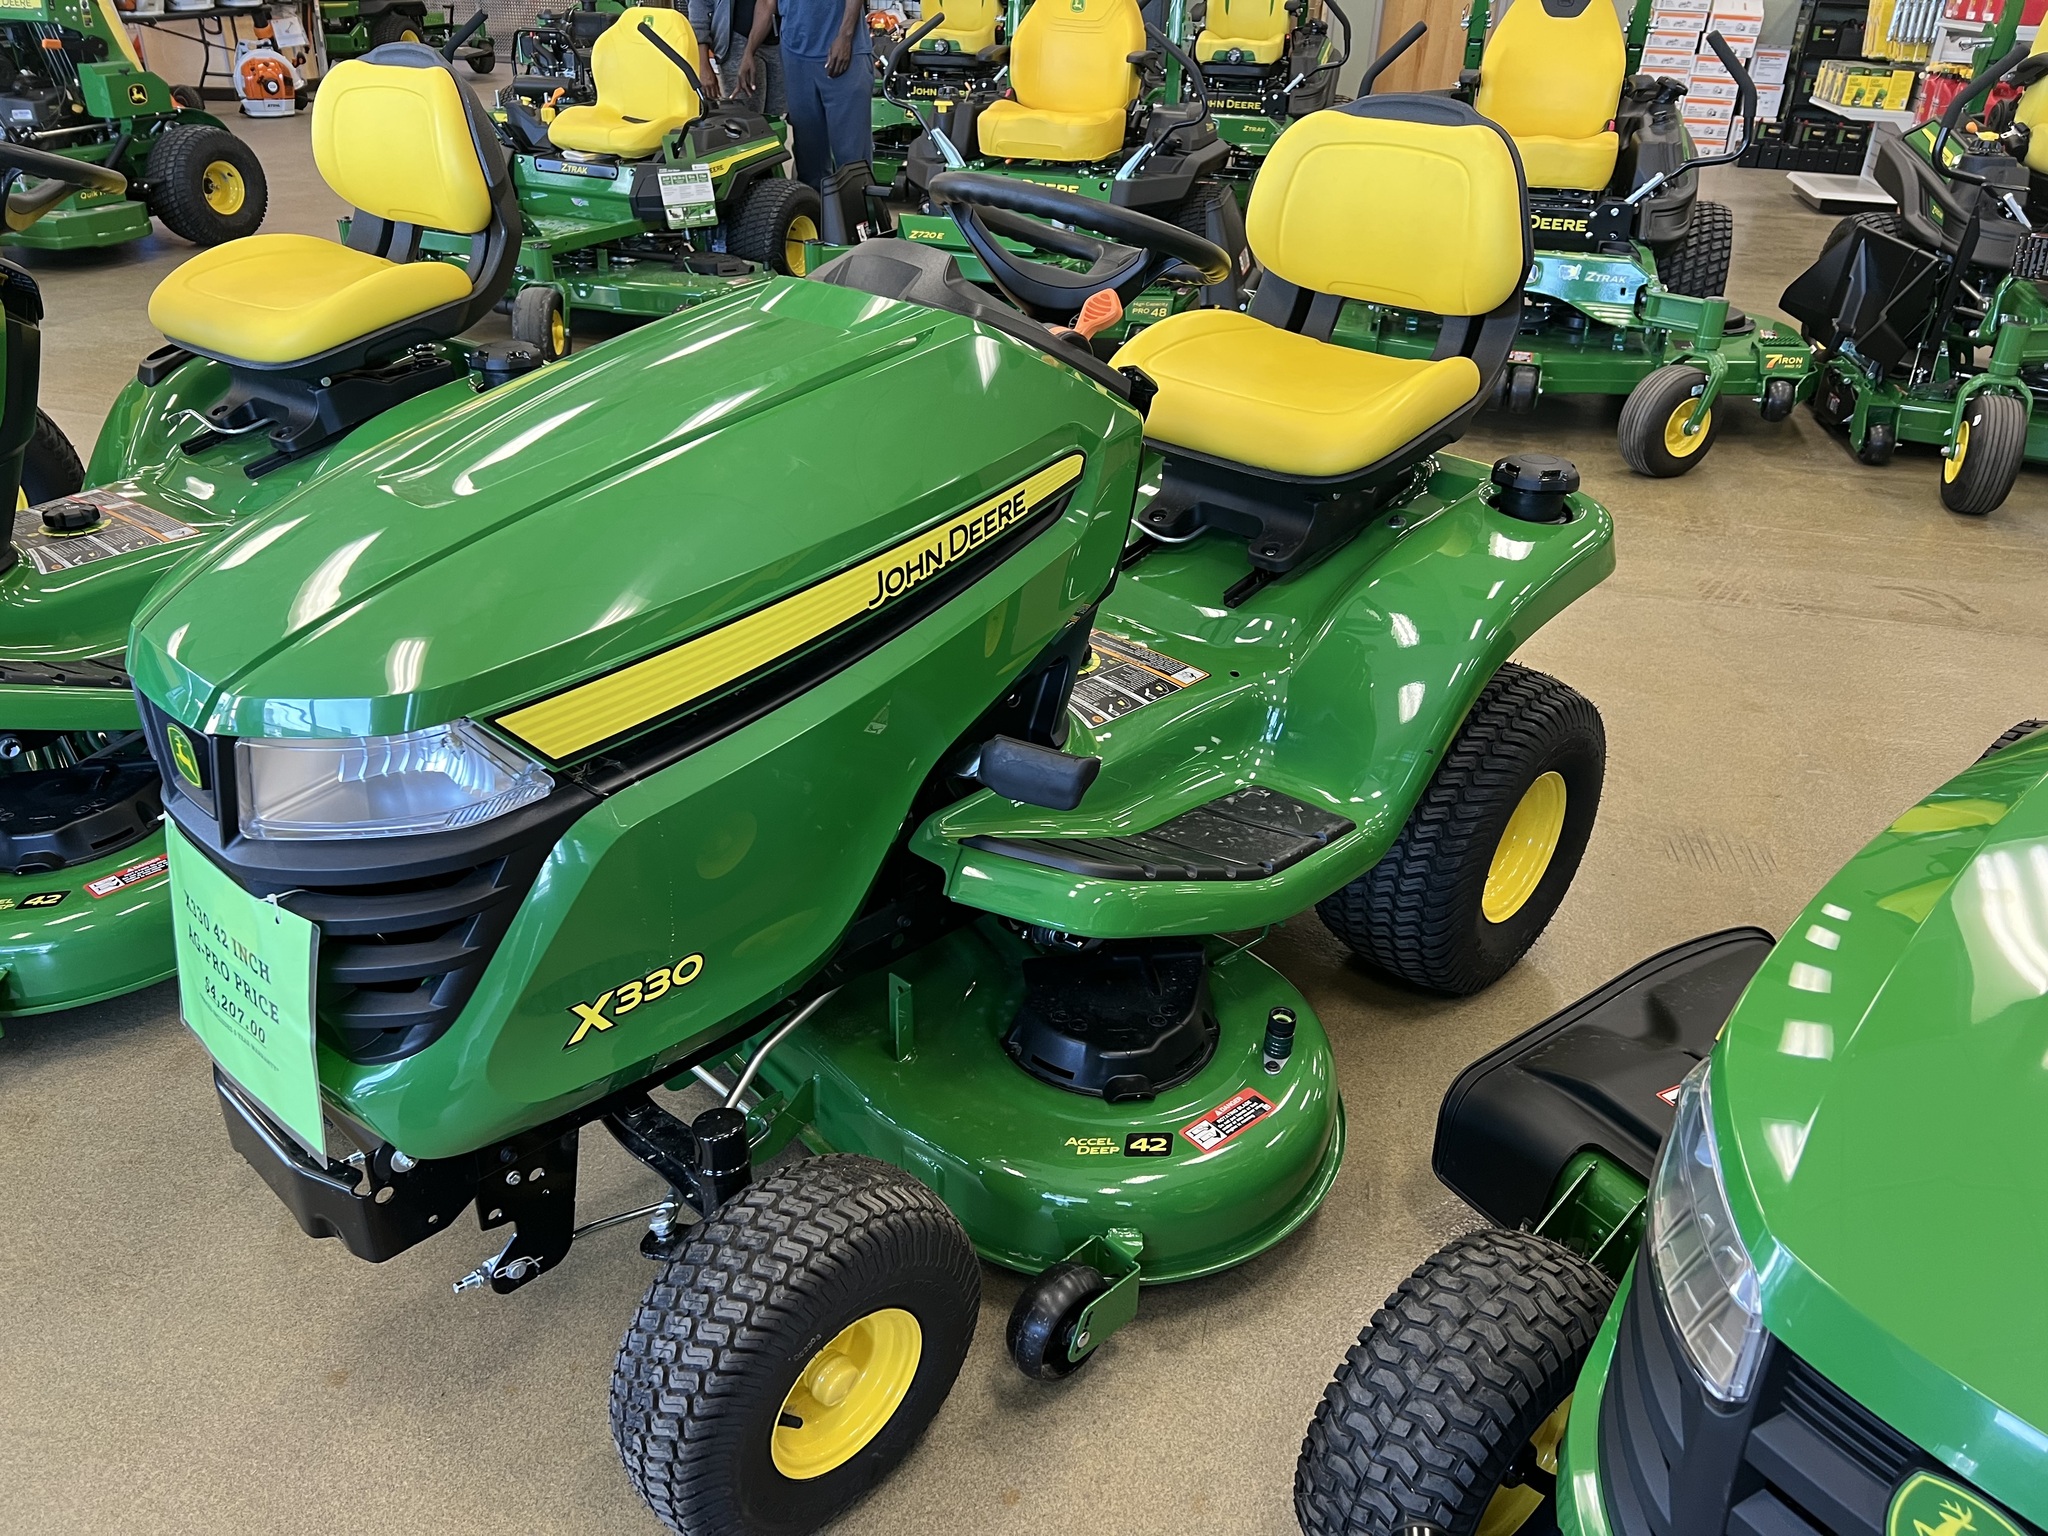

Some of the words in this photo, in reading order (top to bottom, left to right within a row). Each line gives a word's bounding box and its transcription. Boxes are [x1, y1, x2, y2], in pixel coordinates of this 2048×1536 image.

[911, 86, 937, 96] JOHN
[1226, 99, 1261, 110] DEERE
[1242, 125, 1266, 133] ZTRAK
[561, 163, 588, 174] ZTRAK
[80, 190, 98, 200] Quik
[1530, 214, 1588, 232] DEERE
[1584, 271, 1627, 284] ZTRAK
[1132, 307, 1150, 315] PRO
[1150, 307, 1167, 317] 48
[869, 541, 944, 609] JOHN
[949, 488, 1028, 561] DEERE
[24, 894, 62, 906] 42
[213, 923, 229, 950] 42
[231, 936, 271, 985] INCH
[188, 923, 230, 982] AG-PRO
[233, 971, 279, 1025] PRICE
[563, 953, 705, 1050] X330
[204, 976, 266, 1044] $4,207.00
[1064, 1137, 1115, 1146] ACCEL
[1130, 1138, 1167, 1152] 42
[1076, 1146, 1120, 1155] DEEP
